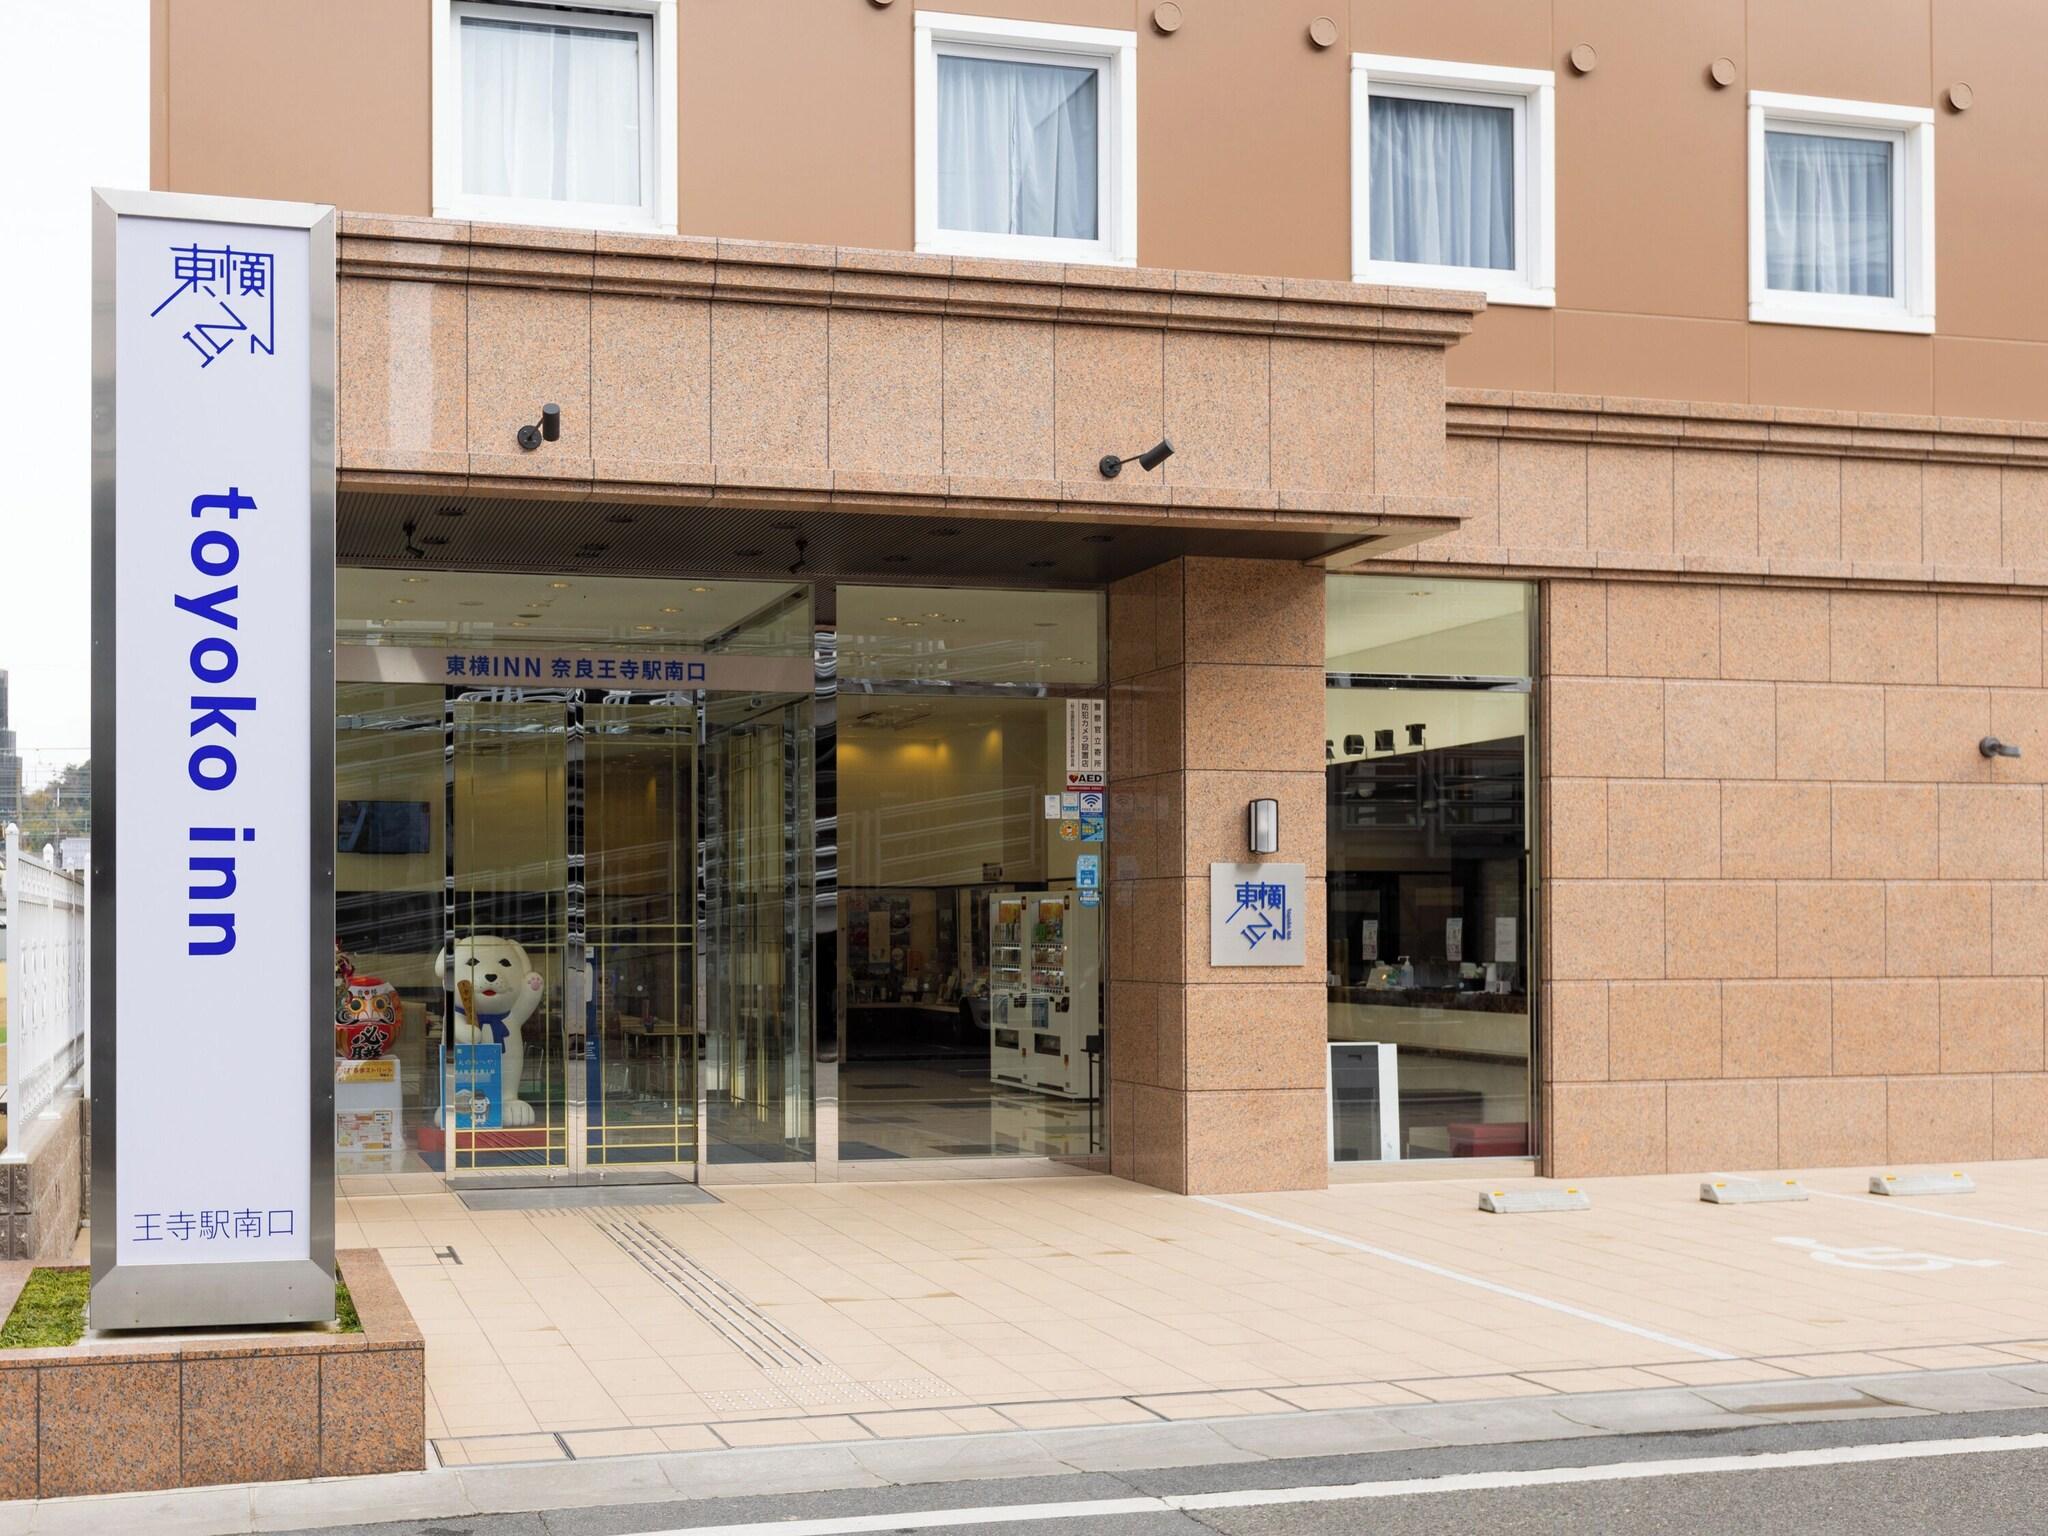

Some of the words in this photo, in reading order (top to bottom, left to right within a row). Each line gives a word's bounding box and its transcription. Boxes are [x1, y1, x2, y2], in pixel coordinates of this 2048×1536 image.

[174, 487, 257, 790] toyoko
[446, 655, 541, 677] 東横INN
[551, 659, 706, 682] 奈良王寺駅南口
[1078, 774, 1102, 782] AED
[189, 827, 256, 956] inn
[132, 1208, 295, 1241] 王寺駅南口
